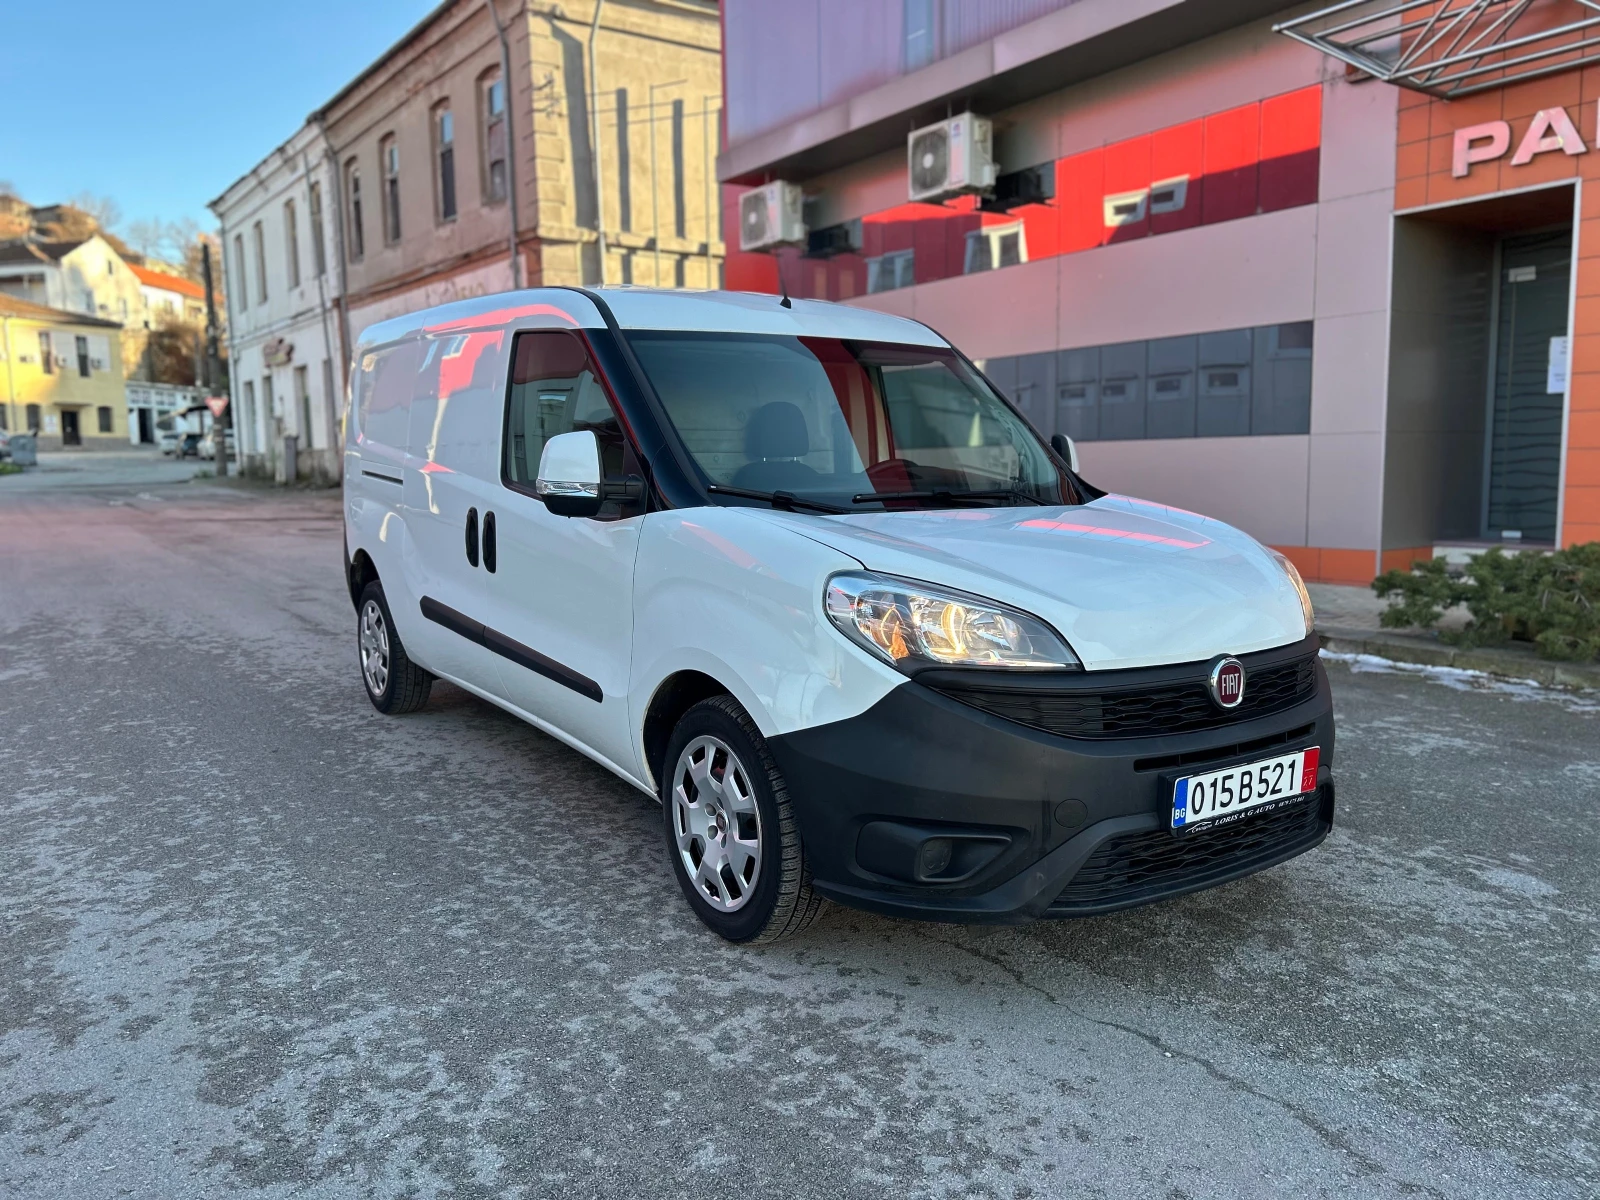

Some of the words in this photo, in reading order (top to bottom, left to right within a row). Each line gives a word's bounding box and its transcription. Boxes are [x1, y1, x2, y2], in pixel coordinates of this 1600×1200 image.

[1452, 97, 1600, 177] PA
[1222, 673, 1240, 696] FIAT
[1191, 759, 1296, 815] 015B521
[1174, 808, 1186, 819] BG
[1215, 813, 1240, 826] LORIS
[1254, 803, 1276, 815] AUTO
